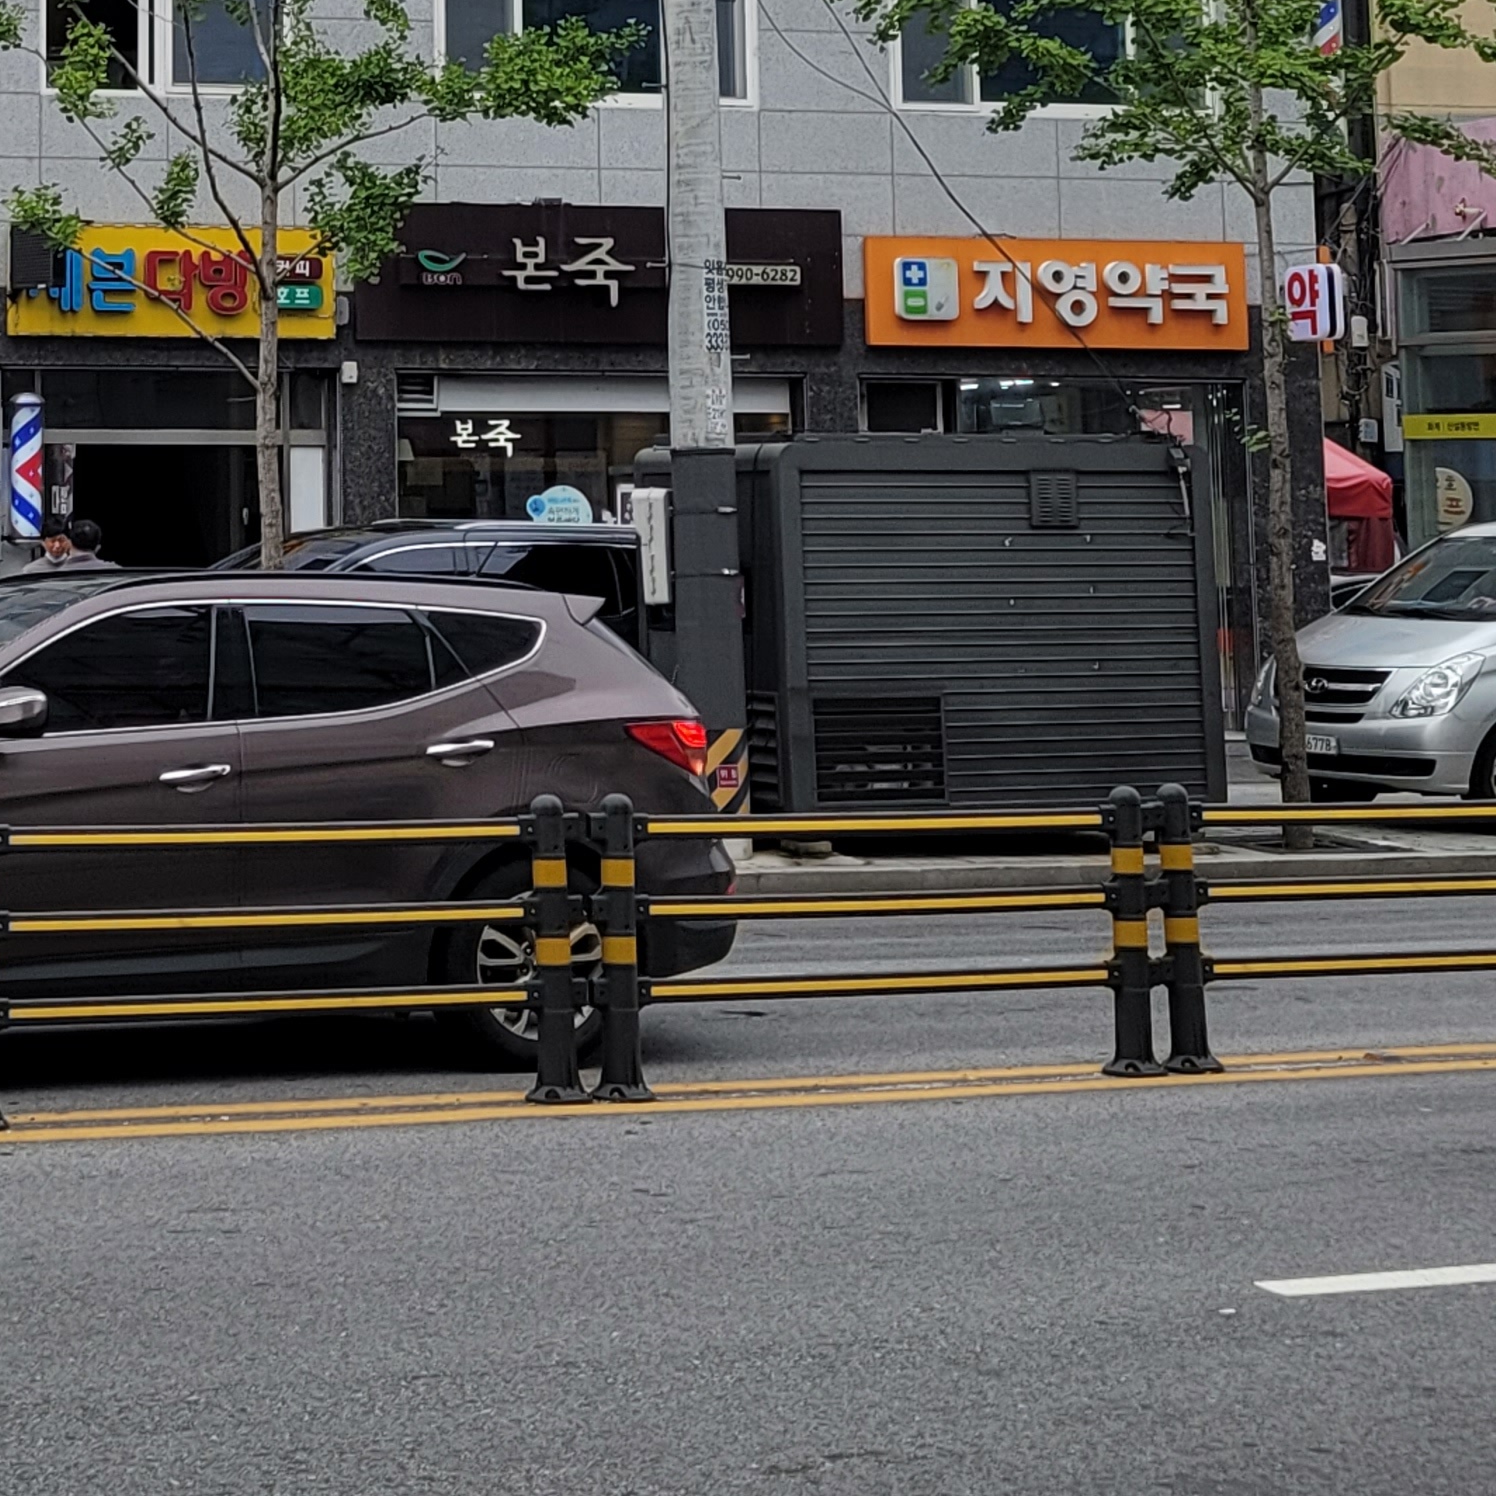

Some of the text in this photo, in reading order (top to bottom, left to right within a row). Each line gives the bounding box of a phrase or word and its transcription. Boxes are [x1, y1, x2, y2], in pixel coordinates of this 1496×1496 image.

[276, 259, 310, 277] 커피
[500, 236, 636, 308] 본죽
[972, 259, 1229, 327] 지영약국
[1287, 269, 1319, 335] 약
[449, 419, 521, 457] 본죽
